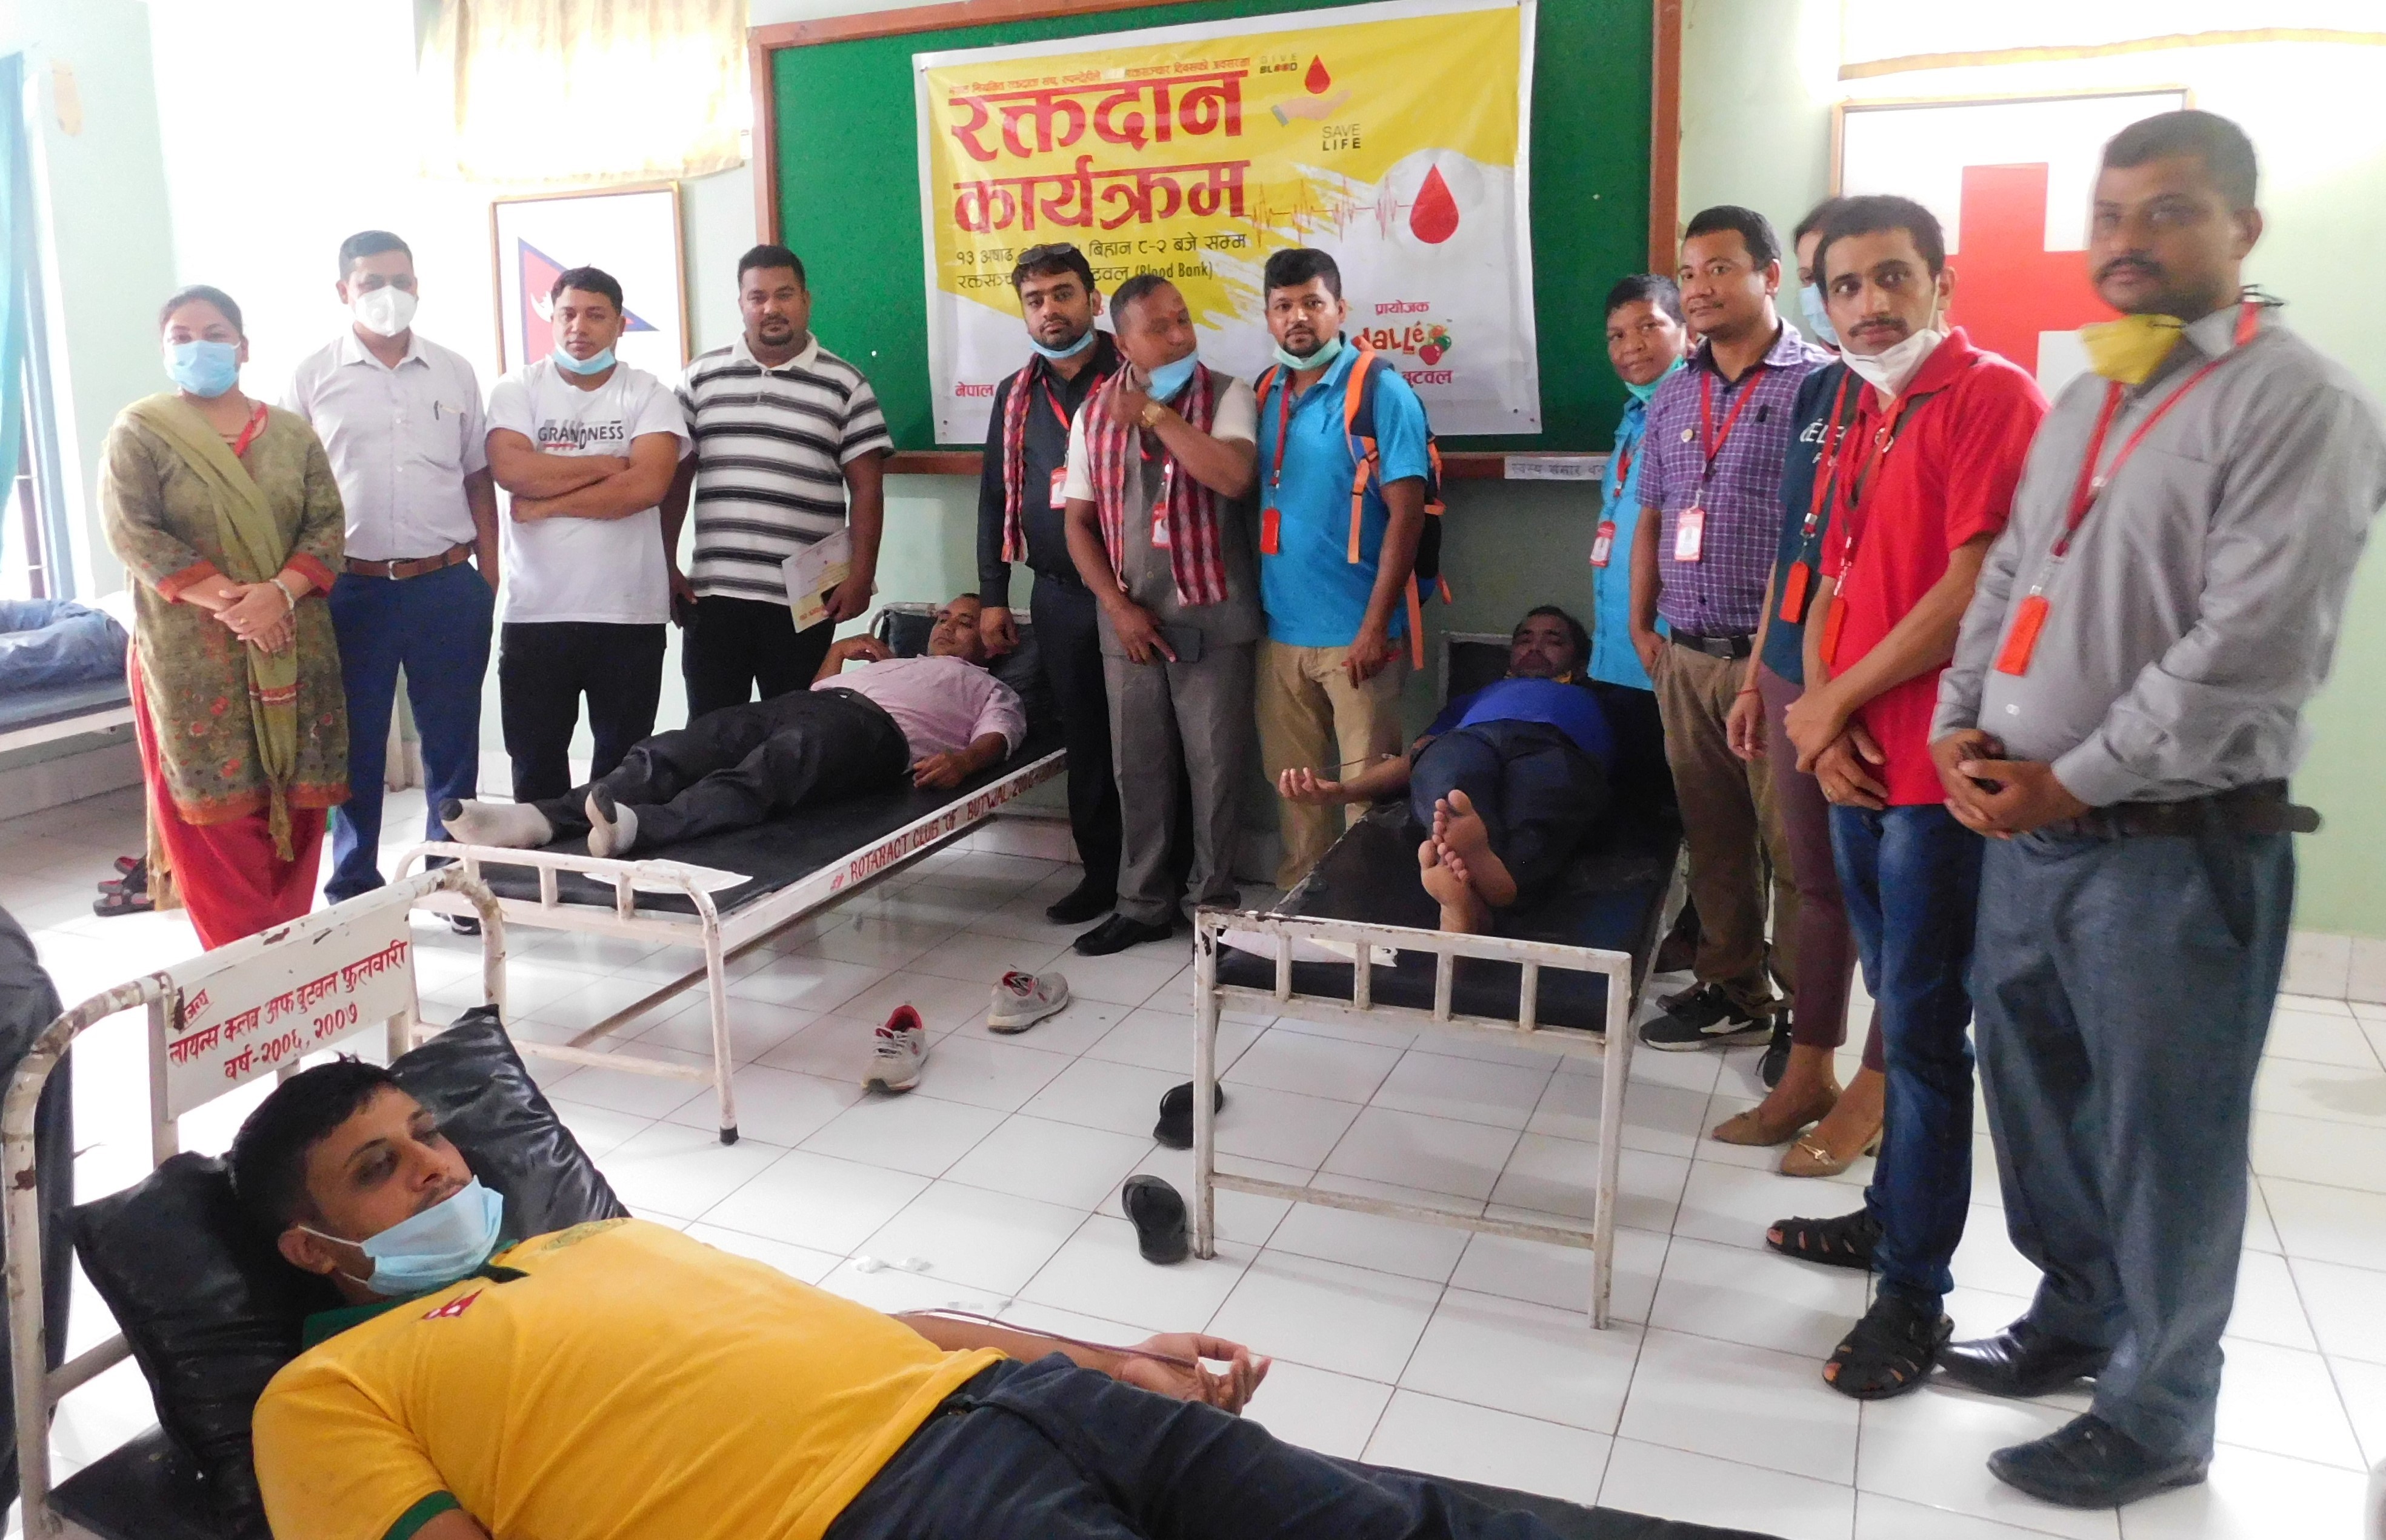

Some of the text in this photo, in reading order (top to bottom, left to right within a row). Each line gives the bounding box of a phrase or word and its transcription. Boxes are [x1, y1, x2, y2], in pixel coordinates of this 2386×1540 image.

[1259, 62, 1298, 74] BLOOD
[948, 69, 1249, 162] रक्तदान
[1322, 123, 1361, 139] SAVE
[1322, 137, 1362, 152] LIFE
[953, 154, 1251, 235] कार्यक्रम
[1088, 239, 1132, 258] बिहान
[1172, 232, 1198, 252] बजे
[1203, 233, 1247, 250] सम्म
[956, 251, 975, 265] १३
[1178, 261, 1213, 280] Bank)
[1375, 299, 1431, 316] प्रायोजक
[955, 381, 995, 398] नेपाल
[538, 425, 624, 450] GRANDNESS
[850, 783, 1009, 882] ROTARACT CLUB OF BUTWAL
[169, 1023, 221, 1067] लायन्स
[341, 939, 408, 993] फुलवारी
